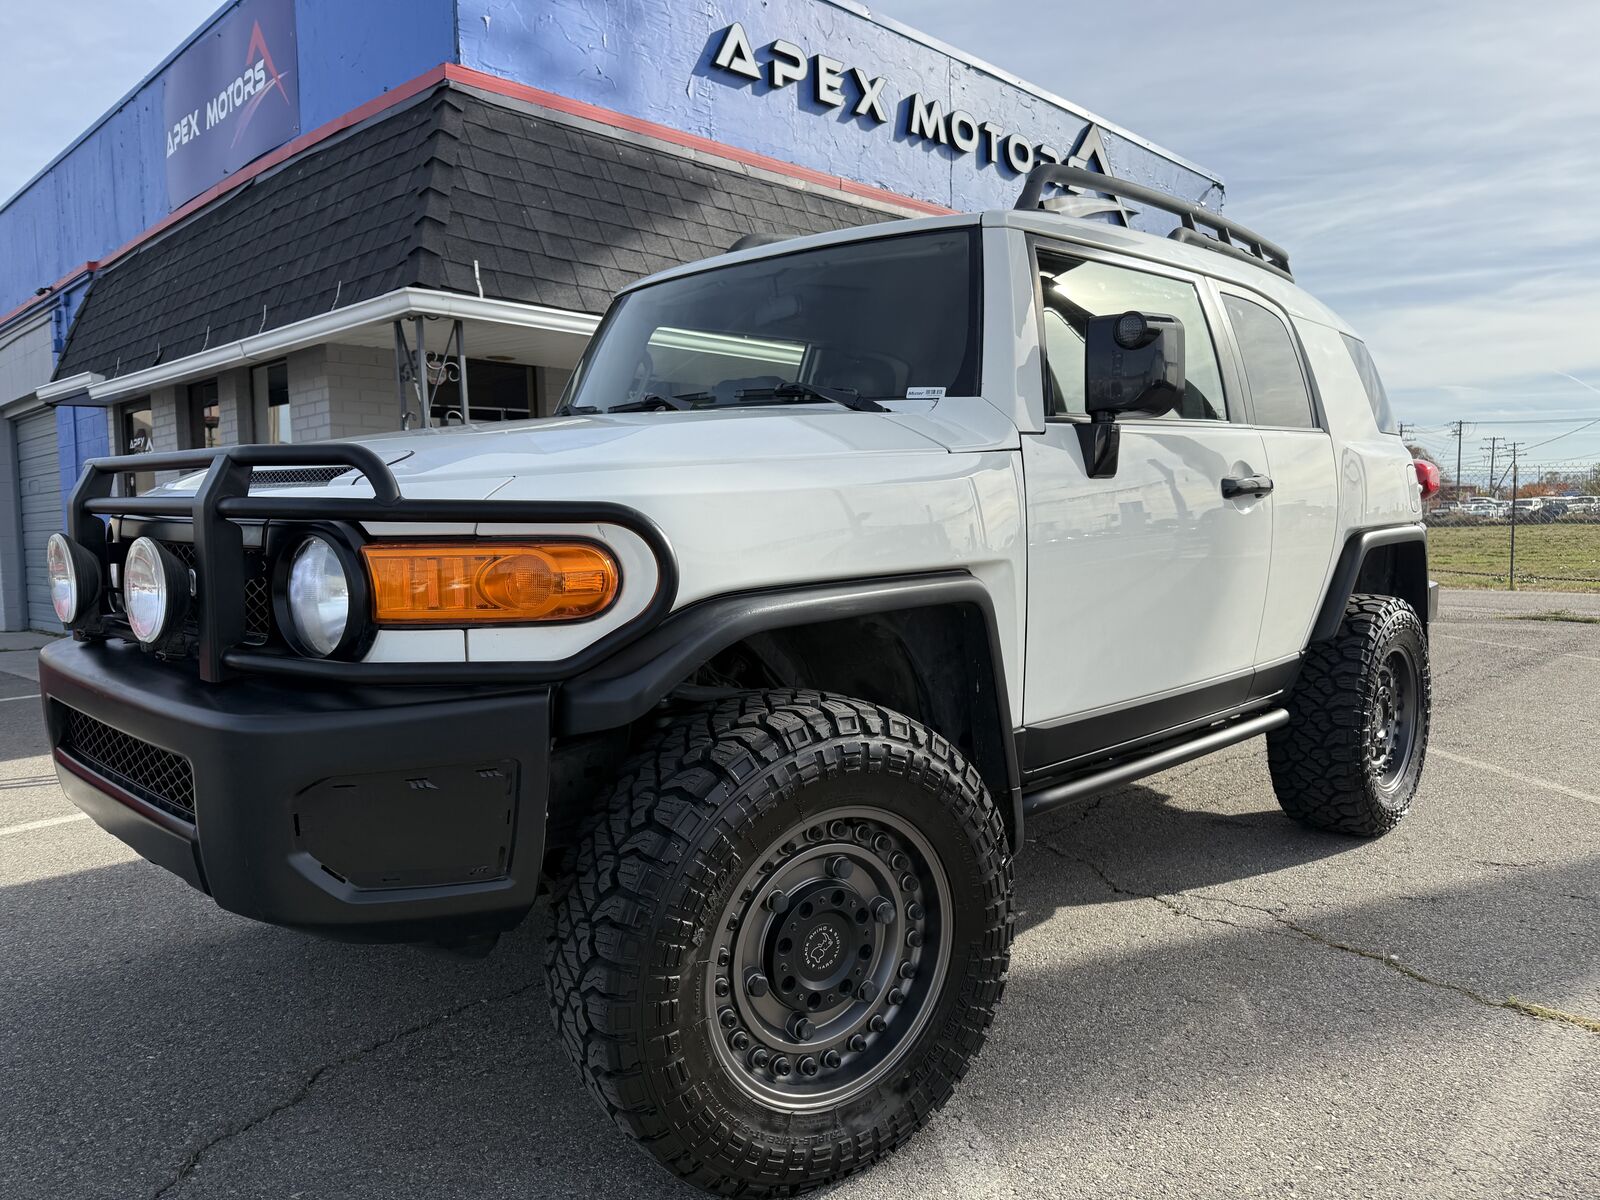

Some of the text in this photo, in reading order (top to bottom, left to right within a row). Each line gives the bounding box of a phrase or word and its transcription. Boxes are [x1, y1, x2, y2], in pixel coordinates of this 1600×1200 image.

[166, 58, 266, 159] APEX MOTORS
[711, 22, 888, 124] APEX
[809, 925, 828, 940] RHINO
